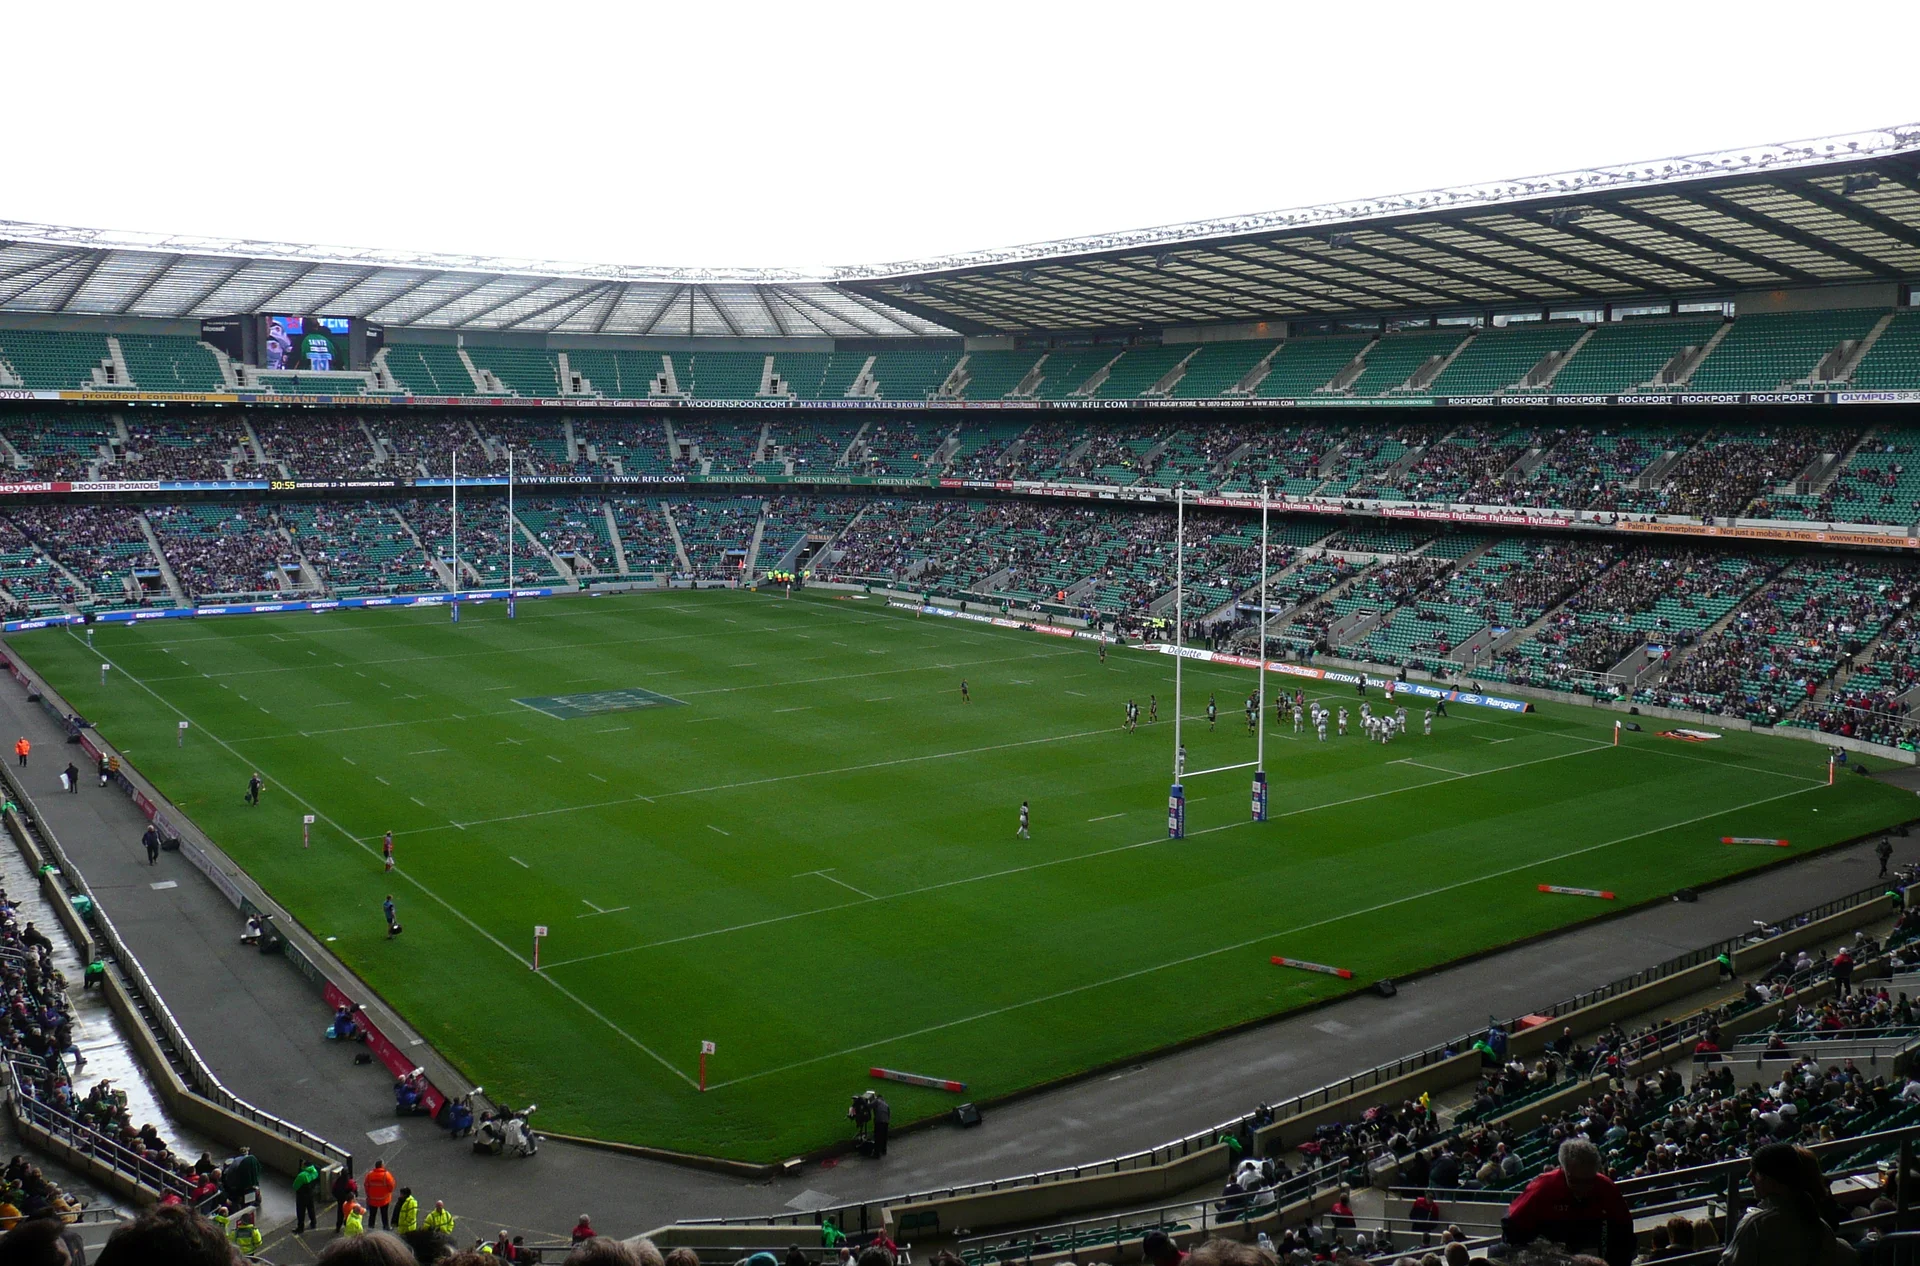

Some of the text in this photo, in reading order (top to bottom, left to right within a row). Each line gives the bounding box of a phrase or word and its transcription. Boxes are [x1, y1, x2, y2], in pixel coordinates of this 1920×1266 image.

[82, 392, 206, 402] proudfoot consulting
[271, 482, 296, 490] 30:55
[1664, 524, 1706, 535] smartphone
[1734, 528, 1749, 537] just
[1756, 530, 1784, 538] mobile.
[1794, 532, 1812, 540] Treo.
[1830, 534, 1904, 545] www.try-treo.com
[1324, 672, 1386, 688] BRITISH AWAYS
[1486, 697, 1520, 710] Ranger
